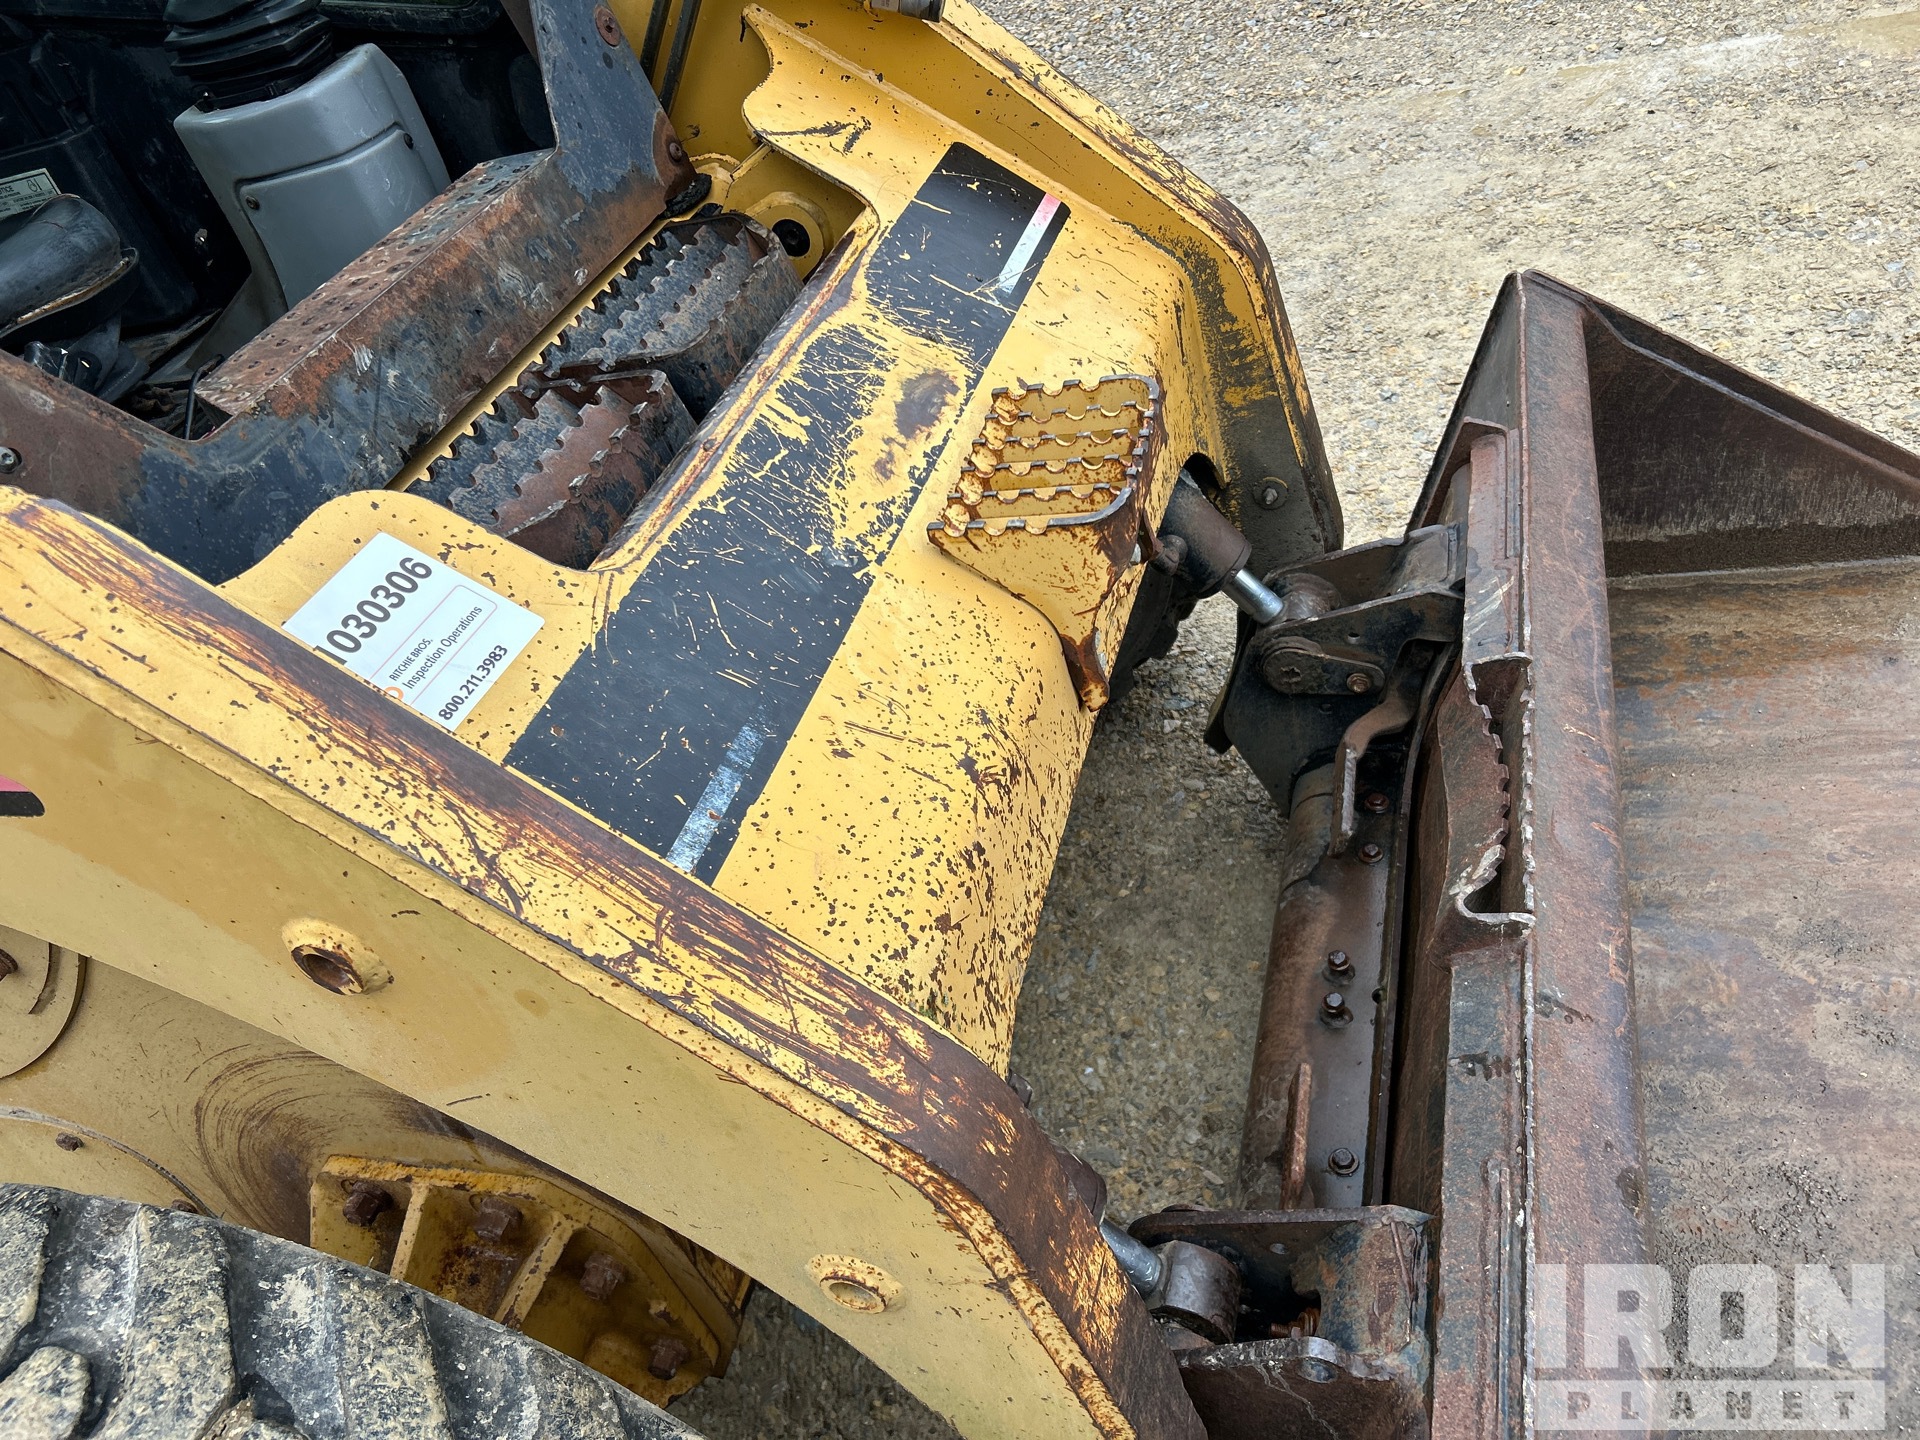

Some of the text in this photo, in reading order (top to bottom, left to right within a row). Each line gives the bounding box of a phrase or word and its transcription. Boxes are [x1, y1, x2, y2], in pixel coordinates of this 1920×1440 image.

[389, 638, 433, 682] RITCHIE BROS.
[402, 606, 483, 690] Inspection Operations
[438, 644, 508, 721] 800.211.3983
